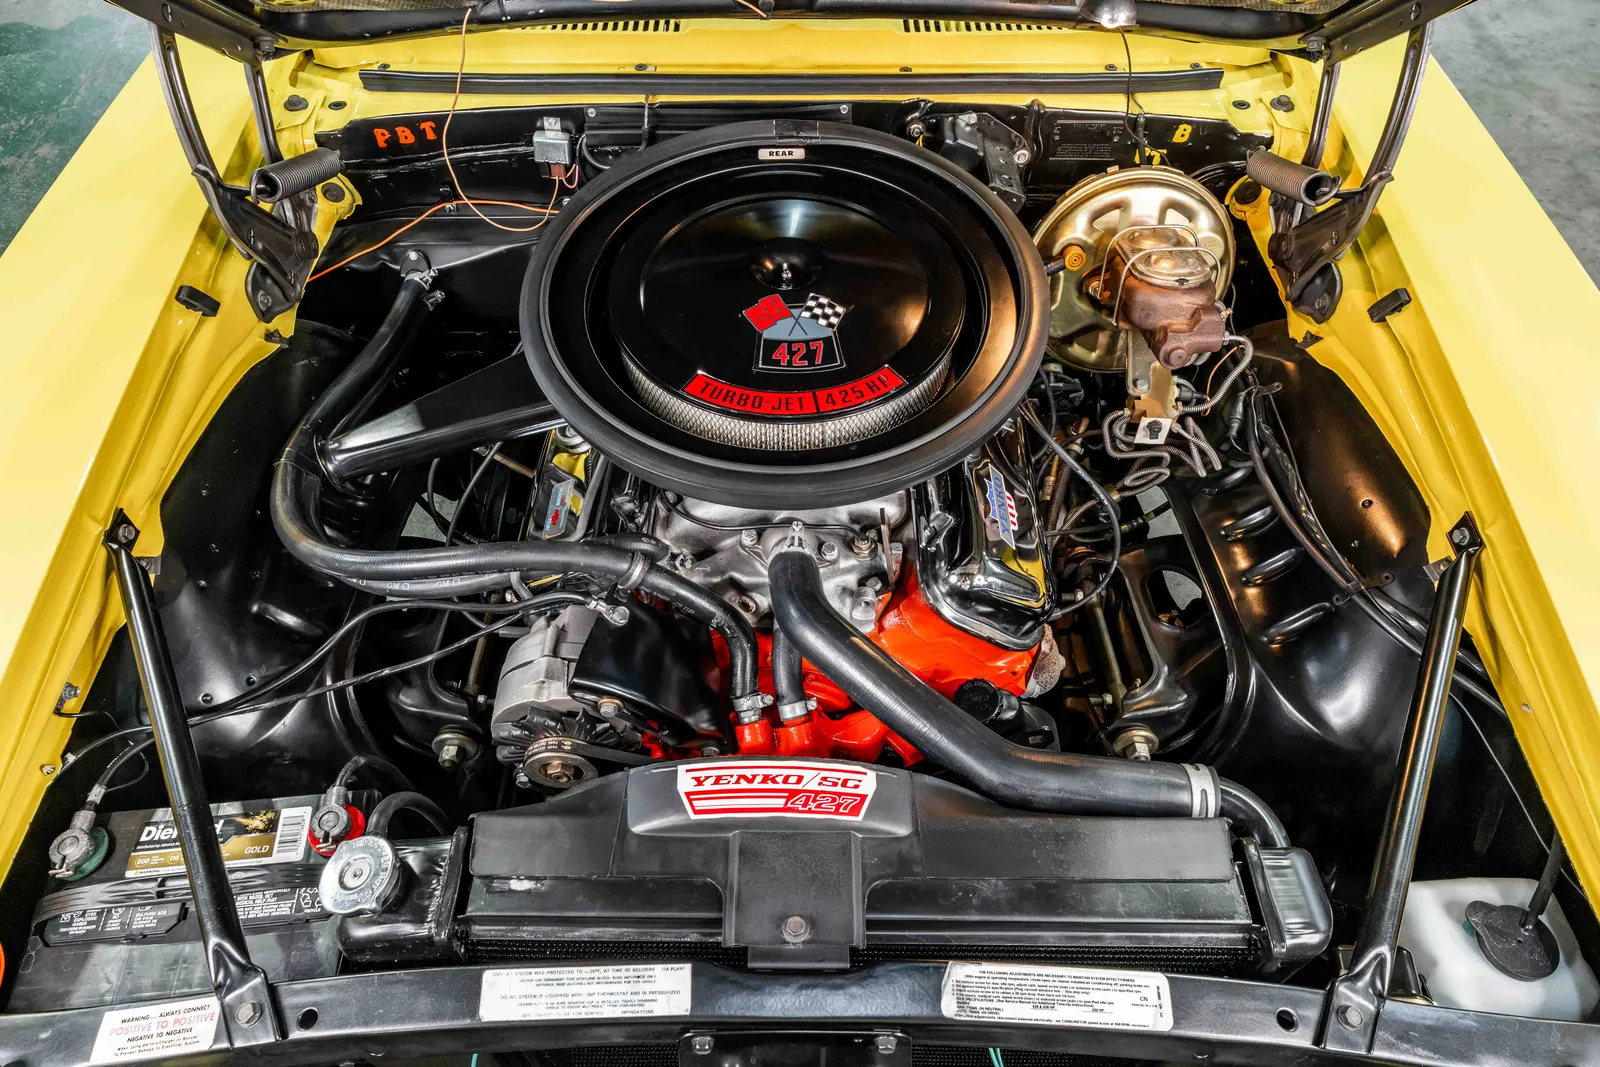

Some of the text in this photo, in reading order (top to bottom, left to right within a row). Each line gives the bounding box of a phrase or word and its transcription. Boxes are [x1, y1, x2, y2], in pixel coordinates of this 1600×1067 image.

[772, 341, 824, 366] 427
[700, 381, 805, 411] TURBO-JET
[825, 373, 889, 406] 425 HP
[994, 476, 1010, 534] YENKO
[436, 580, 450, 588] GM
[788, 793, 860, 813] 427
[244, 845, 270, 854] GOLD
[159, 1009, 181, 1018] ALWAYS
[183, 1004, 210, 1014] CONNECT
[109, 1012, 216, 1036] POSITIVE TO POSITIVE
[127, 1034, 154, 1042] NEGATIVE
[166, 1027, 193, 1036] NEGATIVE
